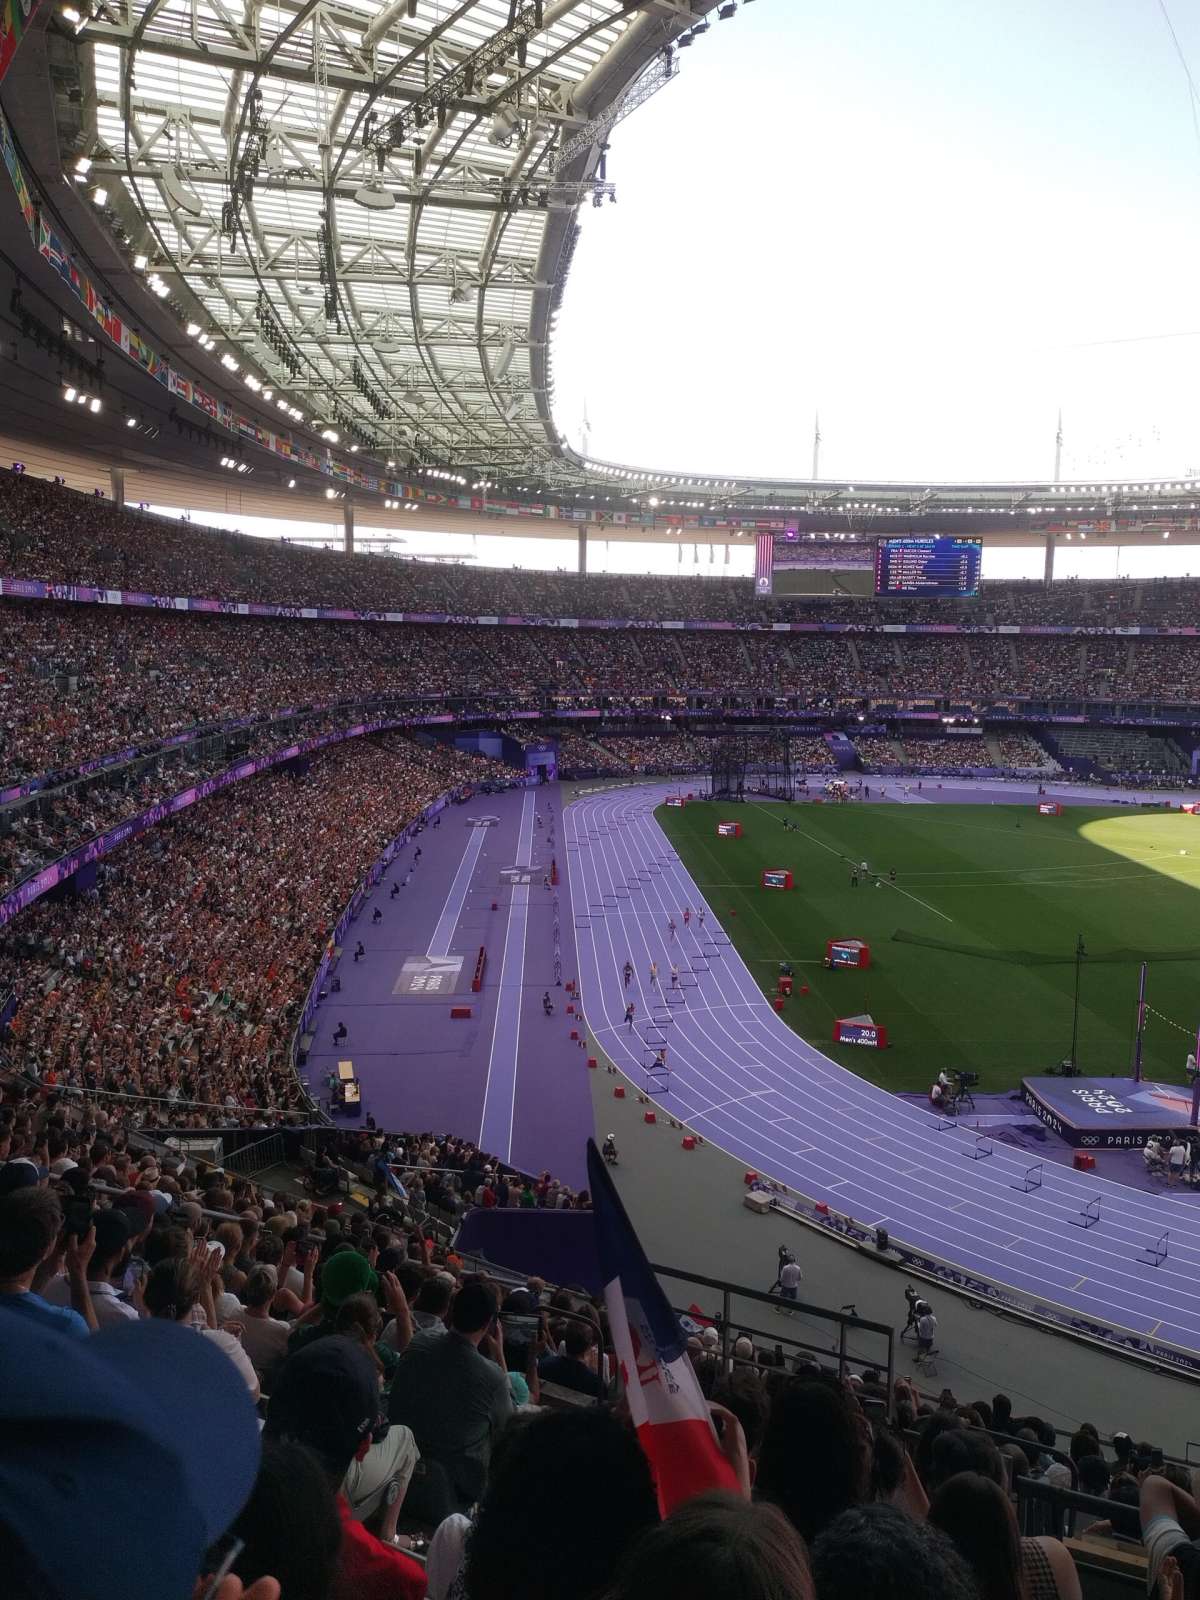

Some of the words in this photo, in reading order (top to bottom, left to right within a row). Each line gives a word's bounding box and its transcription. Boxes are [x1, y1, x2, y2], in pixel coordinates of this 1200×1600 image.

[839, 1035, 856, 1044] Men's
[857, 1038, 878, 1046] 400mH
[860, 1029, 876, 1038] 20.0
[1071, 1089, 1114, 1114] PARIS
[1092, 1089, 1134, 1114] 2024
[1025, 1092, 1041, 1115] PARIS
[1042, 1110, 1063, 1135] 2024
[1107, 1136, 1143, 1145] PARIS
